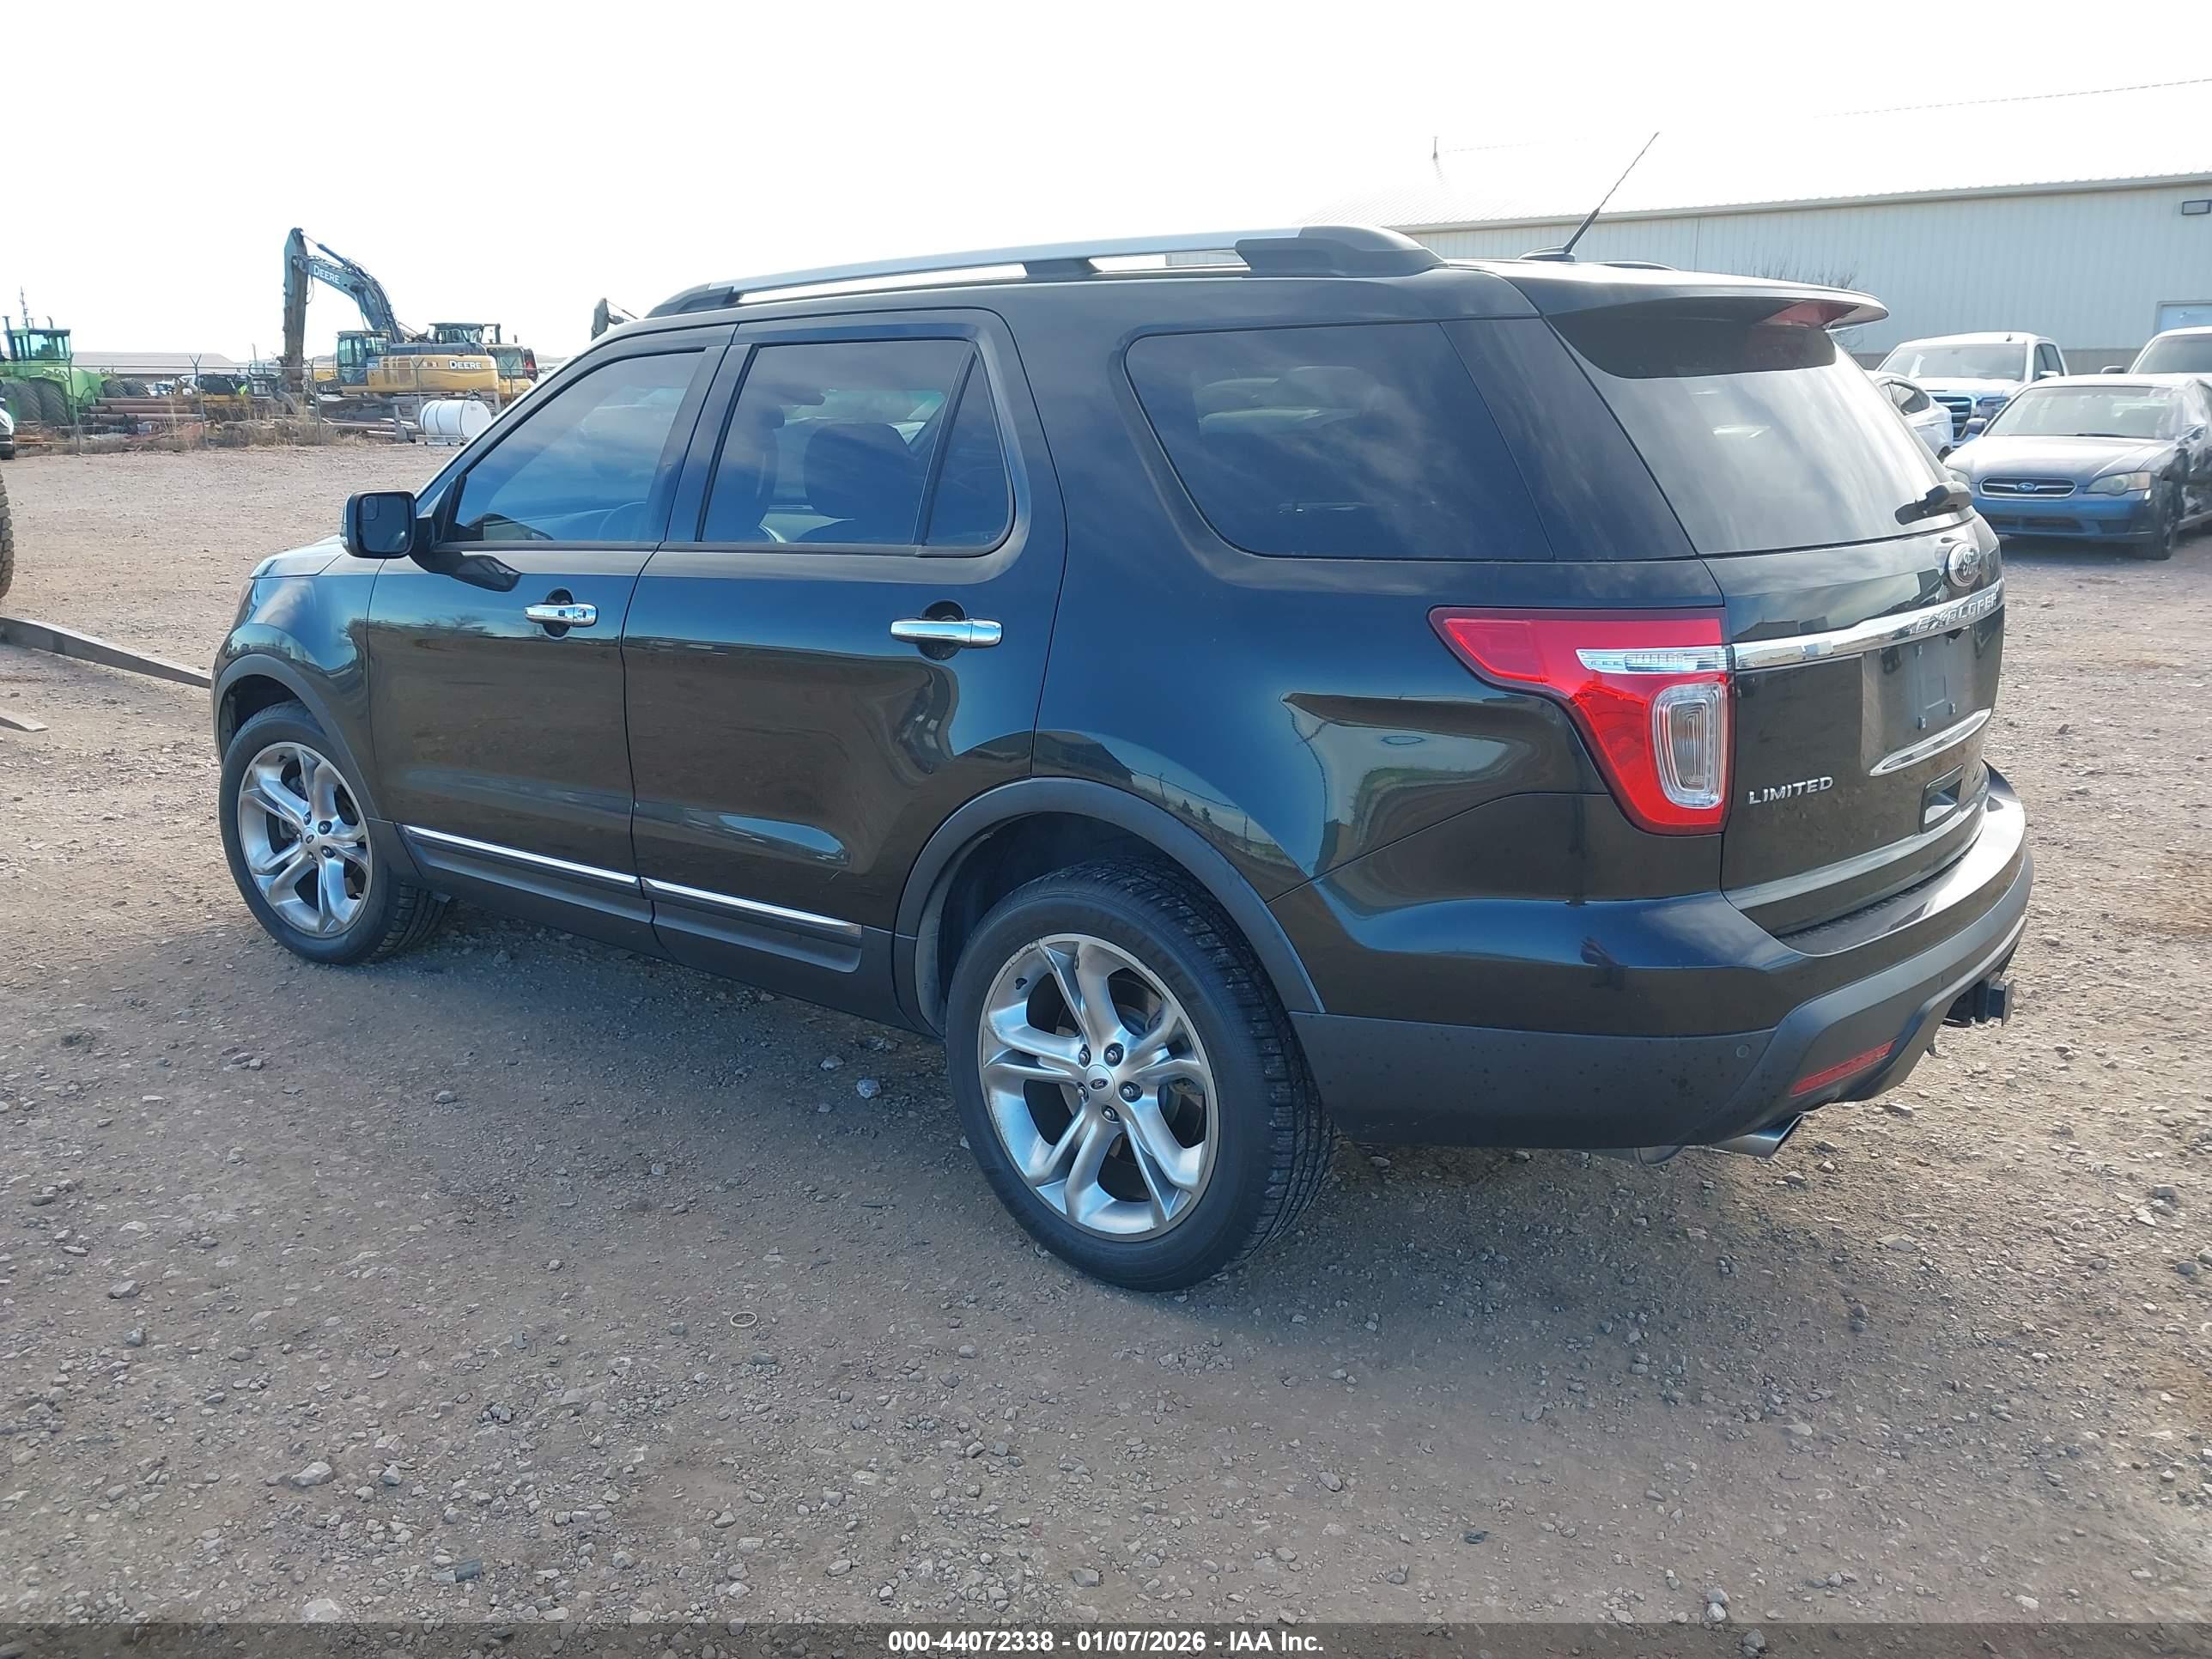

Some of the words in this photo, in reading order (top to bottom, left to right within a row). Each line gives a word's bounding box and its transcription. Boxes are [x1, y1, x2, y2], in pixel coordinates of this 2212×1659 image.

[313, 264, 340, 284] DEERE
[449, 360, 482, 369] DEERE
[1916, 592, 1997, 635] EXPLORER
[1749, 776, 1833, 805] LIMITED
